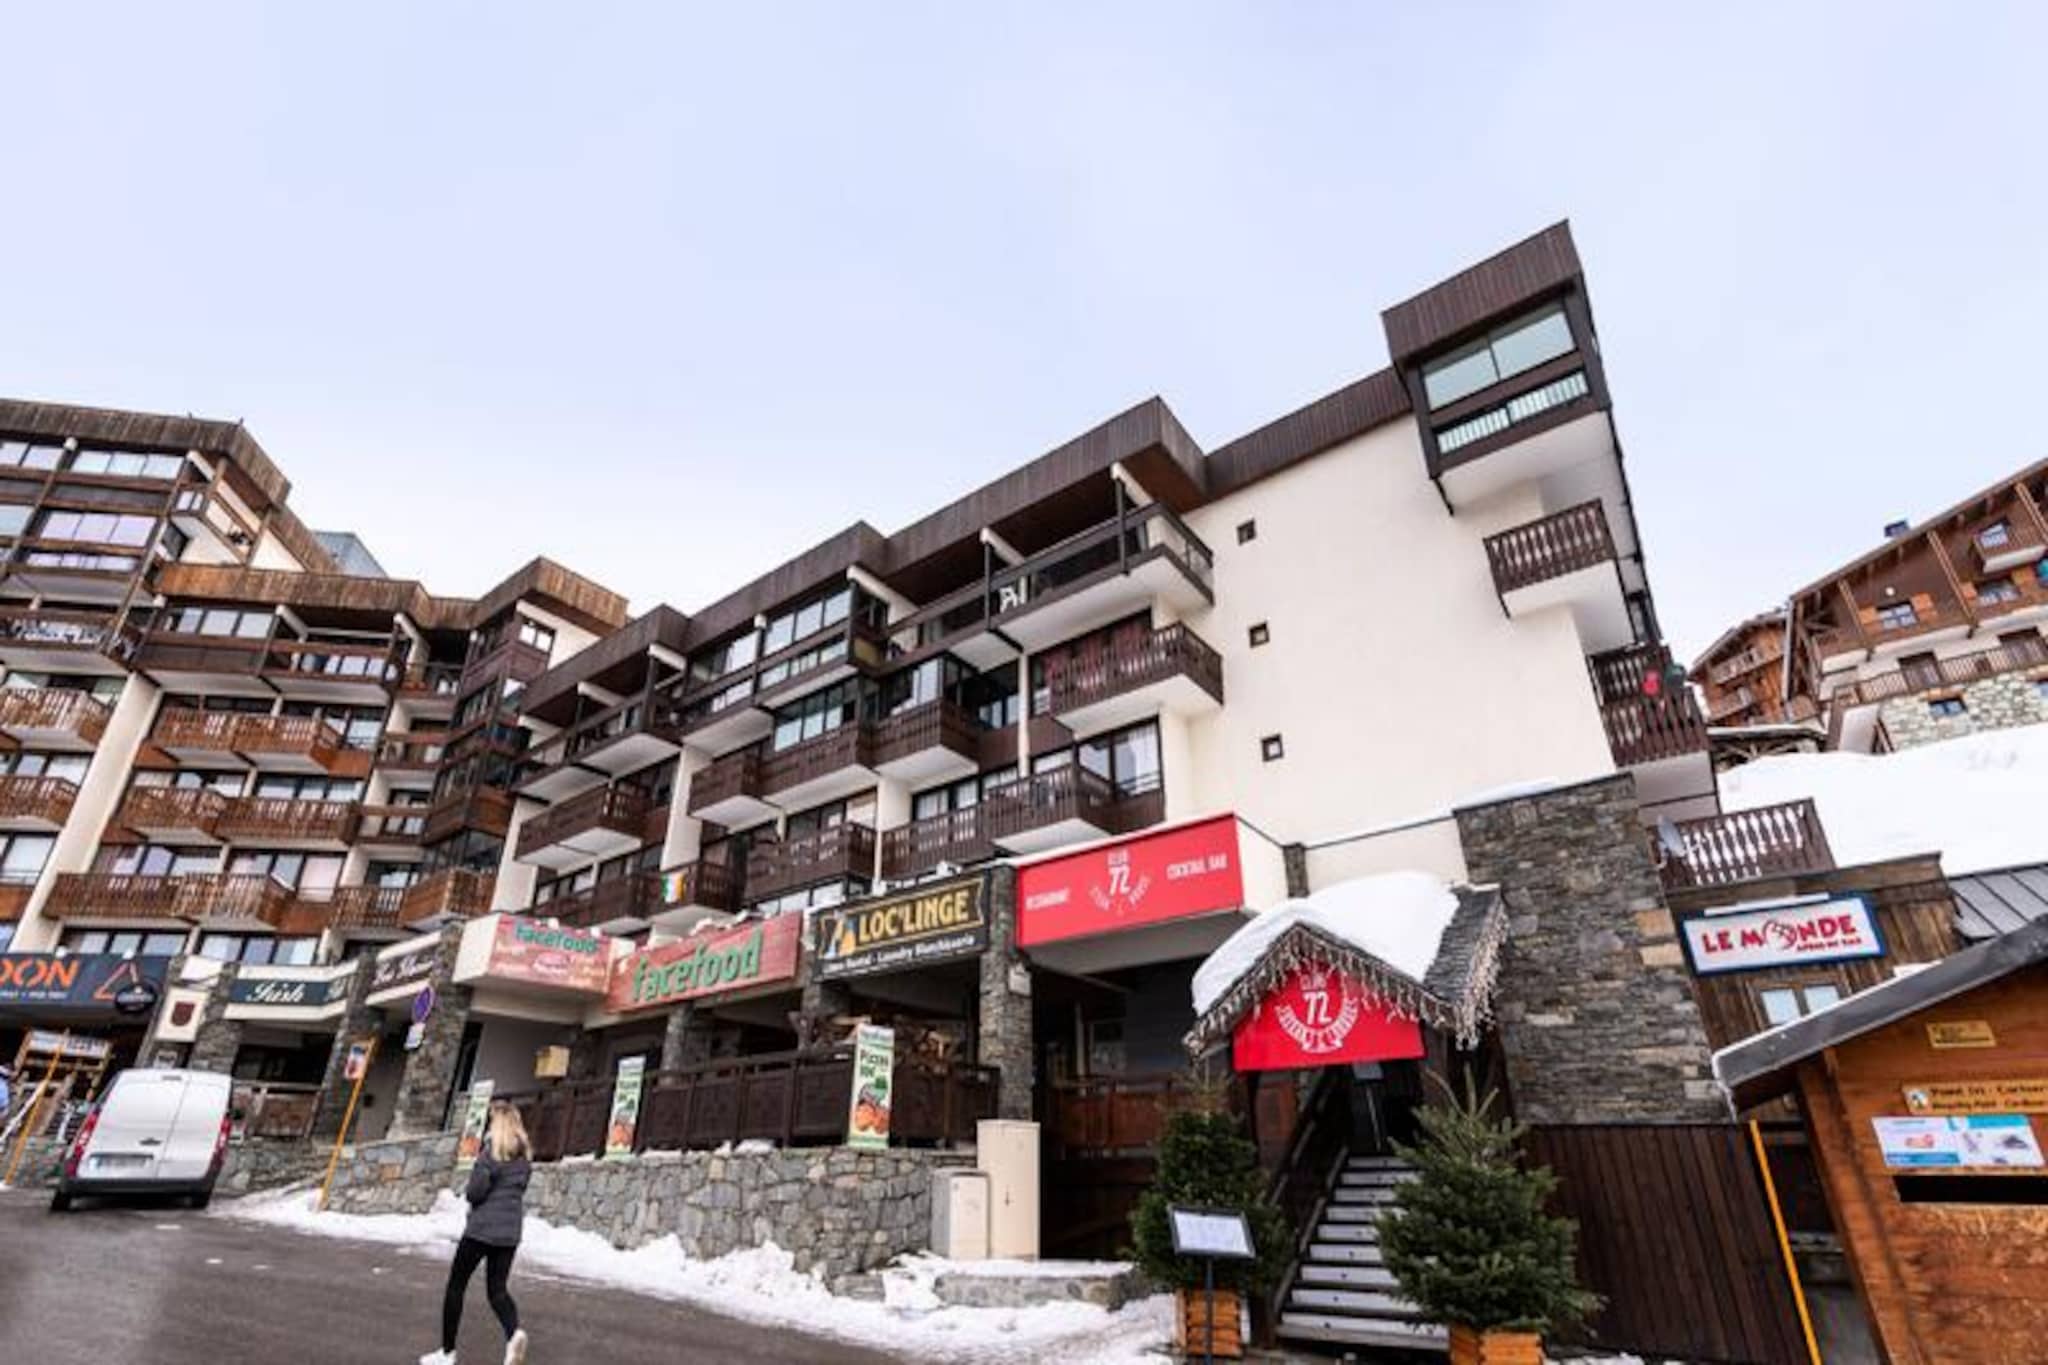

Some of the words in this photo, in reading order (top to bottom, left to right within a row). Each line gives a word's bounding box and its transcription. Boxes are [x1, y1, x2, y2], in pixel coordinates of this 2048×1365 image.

[1207, 852, 1228, 870] BAR
[1108, 865, 1131, 896] 72
[1702, 929, 1734, 953] LE
[1740, 914, 1857, 951] MONDE
[632, 928, 762, 1001] facefood
[246, 981, 305, 1003] Irish
[1303, 990, 1332, 1025] 72
